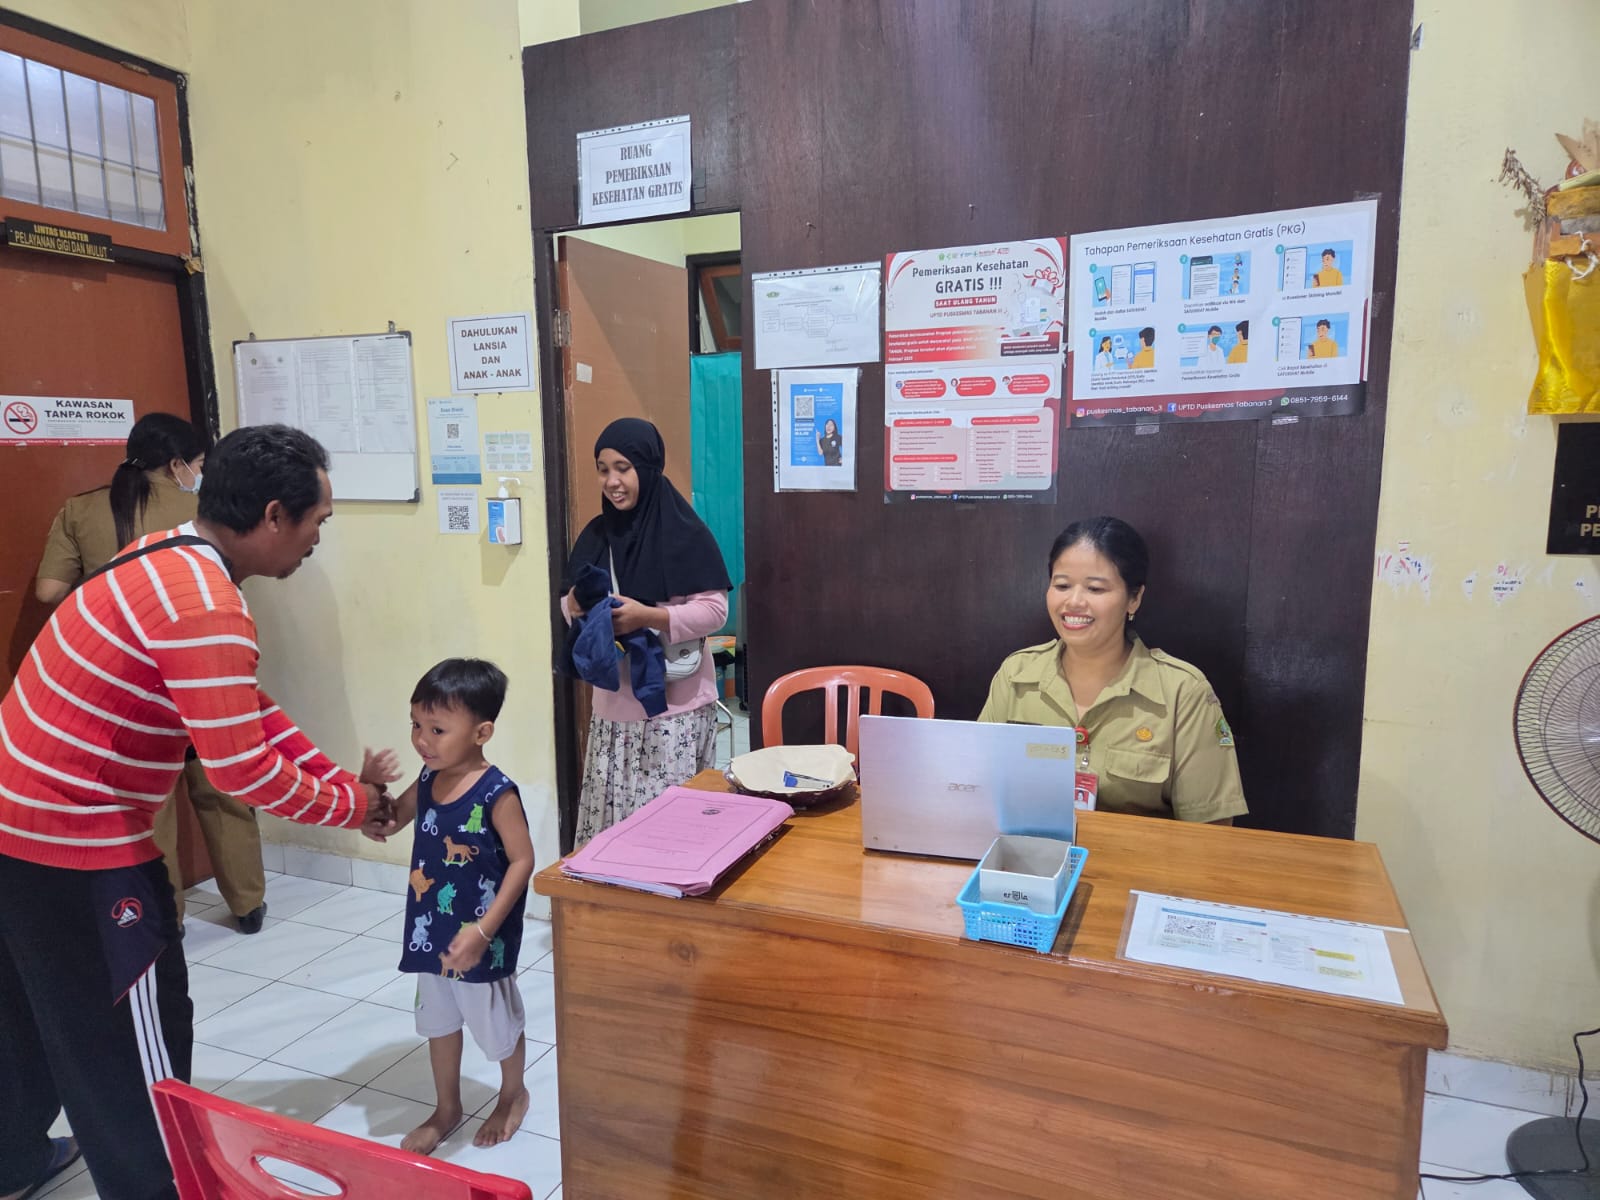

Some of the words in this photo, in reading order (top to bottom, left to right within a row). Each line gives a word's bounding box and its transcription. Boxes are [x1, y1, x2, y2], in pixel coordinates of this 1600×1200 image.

[620, 144, 652, 160] RUANG
[606, 162, 672, 184] PEMERIKSAAN
[592, 186, 645, 206] KESEHATAN
[648, 182, 683, 198] GRATIS
[34, 224, 58, 237] LINTAS
[59, 229, 88, 242] KLASTER
[15, 230, 56, 249] PELAYANAN
[56, 239, 70, 253] GIGI
[72, 242, 85, 254] DAN
[86, 244, 108, 258] MULUT
[1084, 242, 1125, 257] Tahapan
[1127, 236, 1188, 252] Pemeriksaan
[1189, 232, 1242, 246] Kesehatan
[1244, 228, 1274, 240] Gratis
[1276, 222, 1306, 237] (PKG)
[912, 264, 973, 278] Pemeriksaan
[976, 259, 1029, 272] Kesehatan
[936, 278, 984, 294] GRATIS
[989, 276, 1002, 290] !!!
[935, 299, 951, 307] SAAT
[953, 298, 974, 306] ULANG
[975, 296, 996, 304] TAHUN
[461, 326, 518, 338] DAHULUKAN
[474, 341, 507, 351] LANSIA
[482, 356, 500, 365] DAN
[464, 370, 488, 379] ANAK
[496, 369, 522, 378] ANAK
[56, 400, 112, 409] KAWASAN
[1290, 394, 1348, 404] 0851-7959-6144
[45, 410, 82, 418] TANPA
[86, 411, 125, 419] ROKOK
[1086, 405, 1162, 416] puskesmas_tabanan_3
[1586, 505, 1600, 518] P
[948, 782, 981, 793] acer
